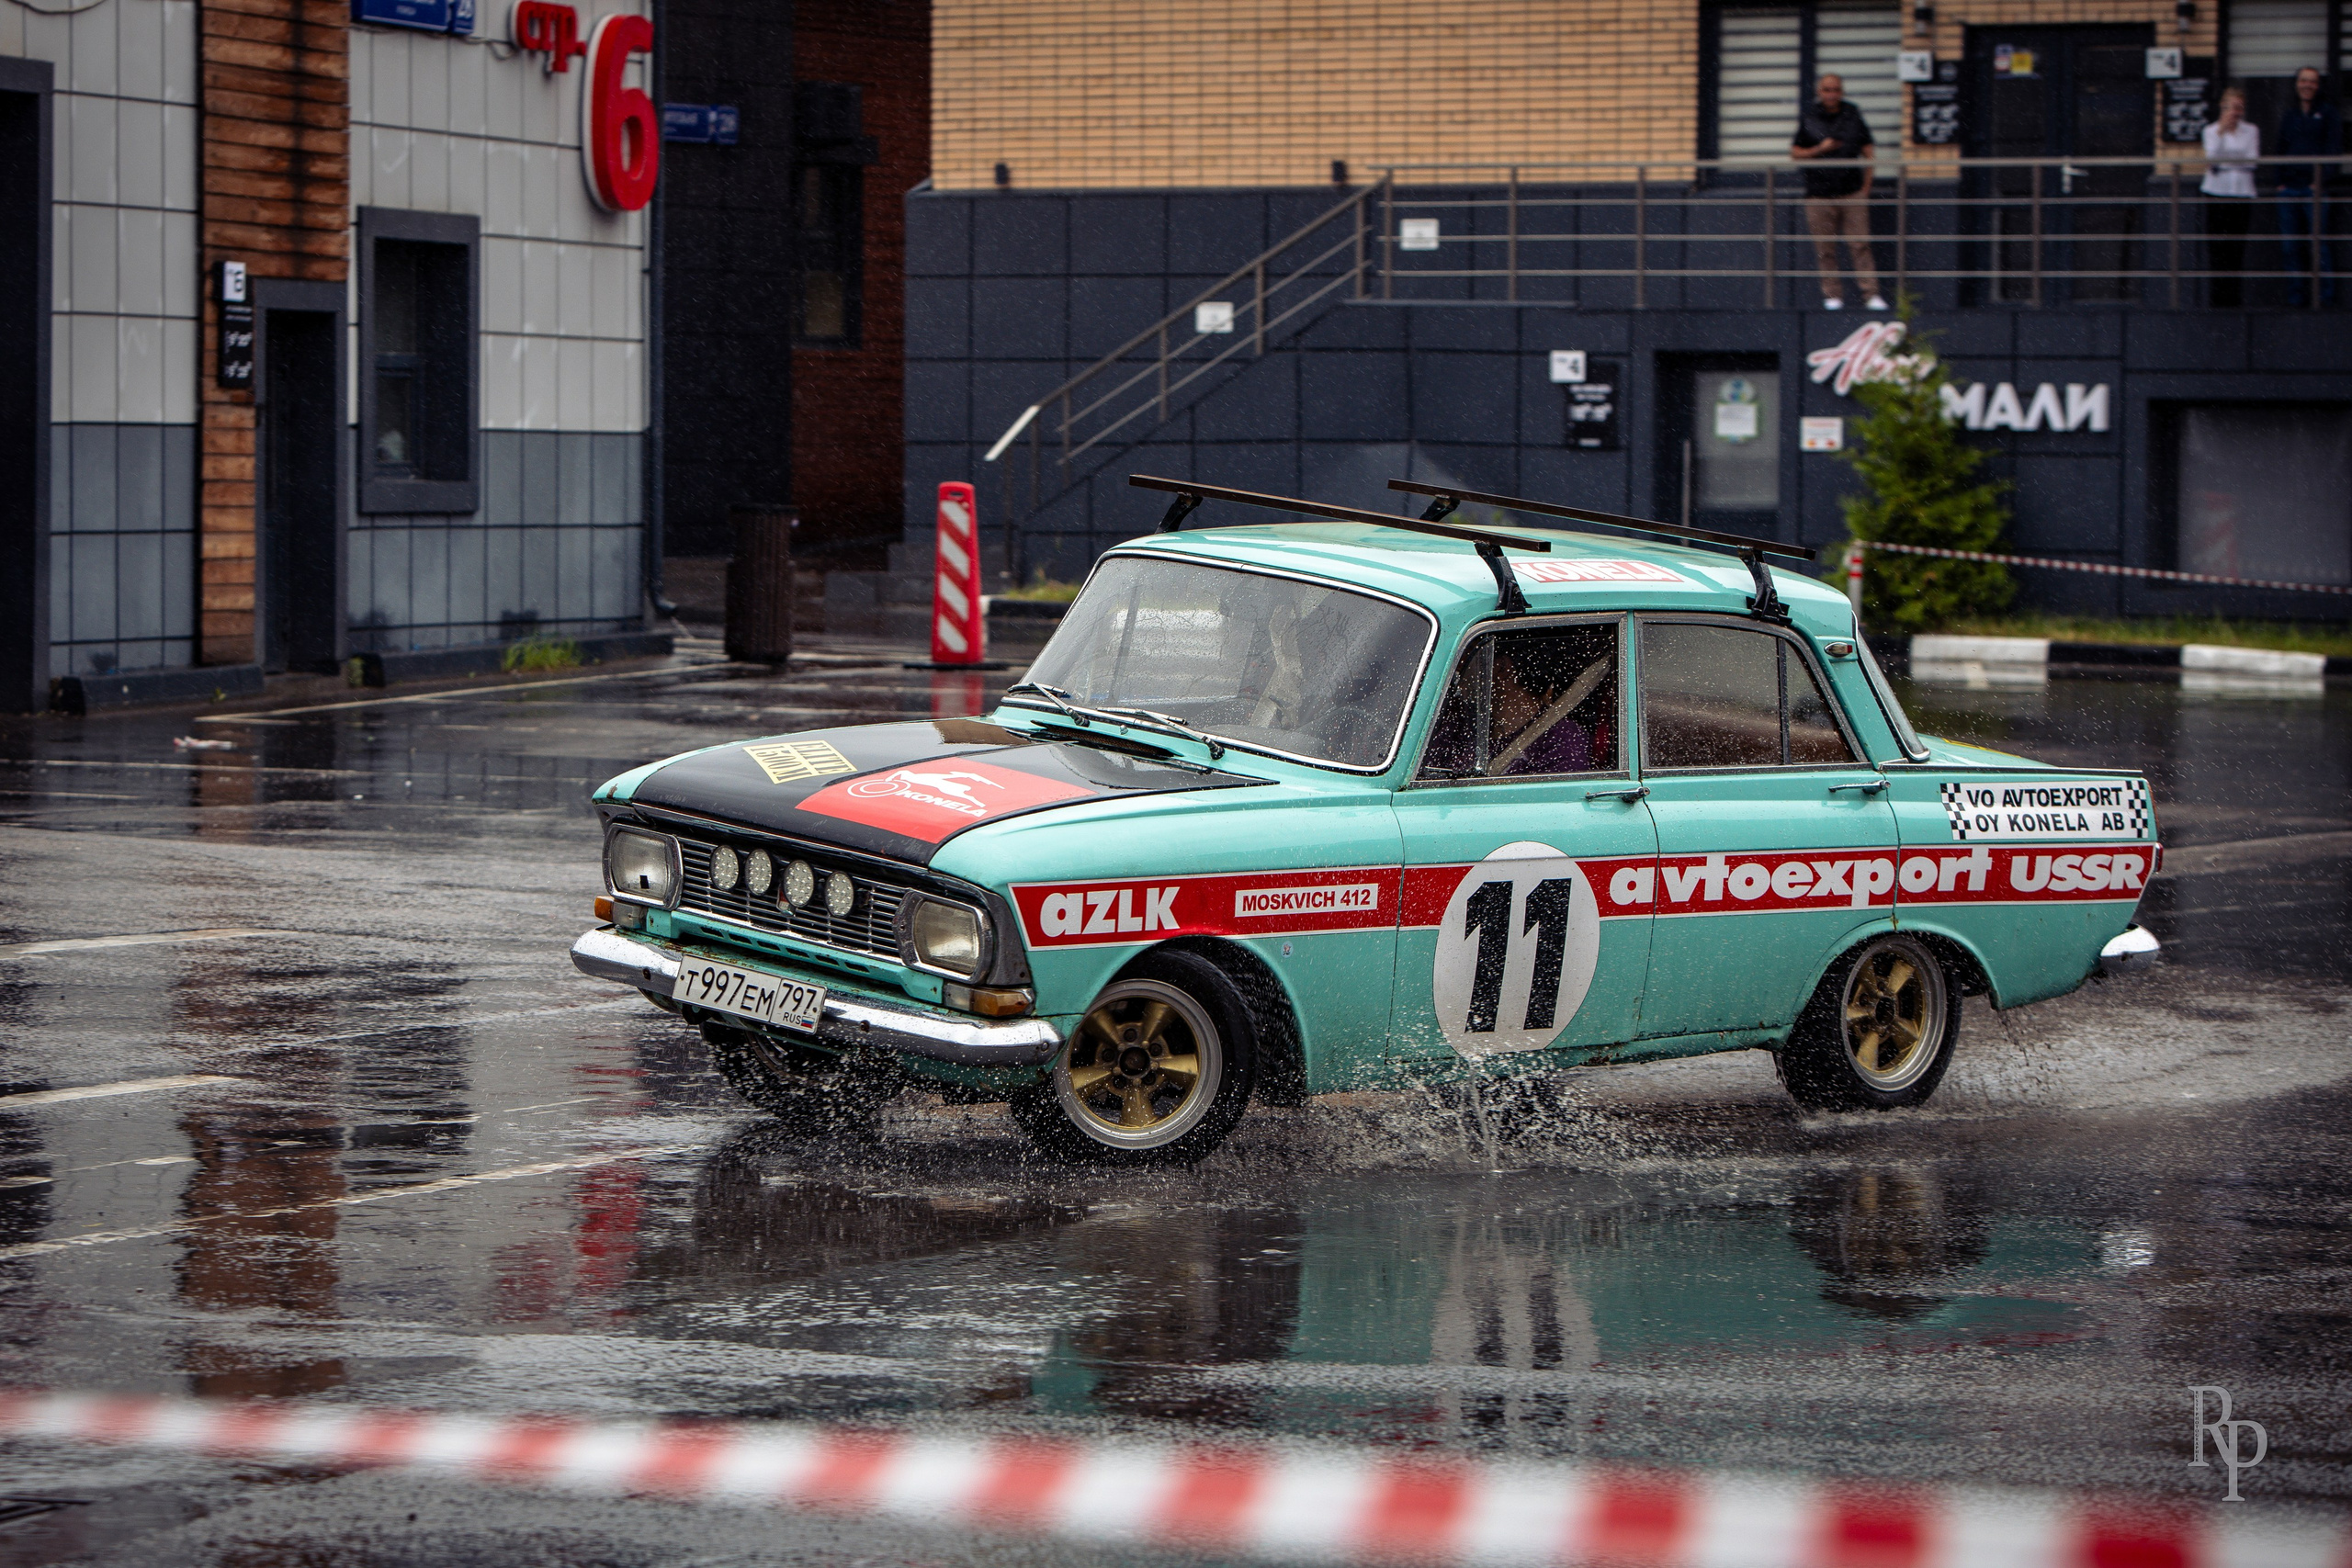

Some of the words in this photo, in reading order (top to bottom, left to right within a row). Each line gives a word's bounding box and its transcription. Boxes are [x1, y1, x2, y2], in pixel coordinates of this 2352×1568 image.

[582, 14, 660, 211] 6
[1511, 561, 1676, 581] KONELA
[895, 789, 989, 818] KONELA
[1966, 789, 1995, 807] VO
[2002, 787, 2123, 807] AVTOEXPORT
[1975, 813, 1999, 832] OY
[2007, 812, 2090, 832] KONELA
[2101, 812, 2125, 831] AB
[1610, 847, 1993, 908] avtoexport
[2009, 853, 2145, 893] USSR
[1241, 891, 1336, 912] MOSKVICH
[1340, 888, 1371, 907] 412
[1464, 877, 1573, 1033] 11
[778, 982, 818, 1014] 797
[782, 1011, 802, 1025] RUS
